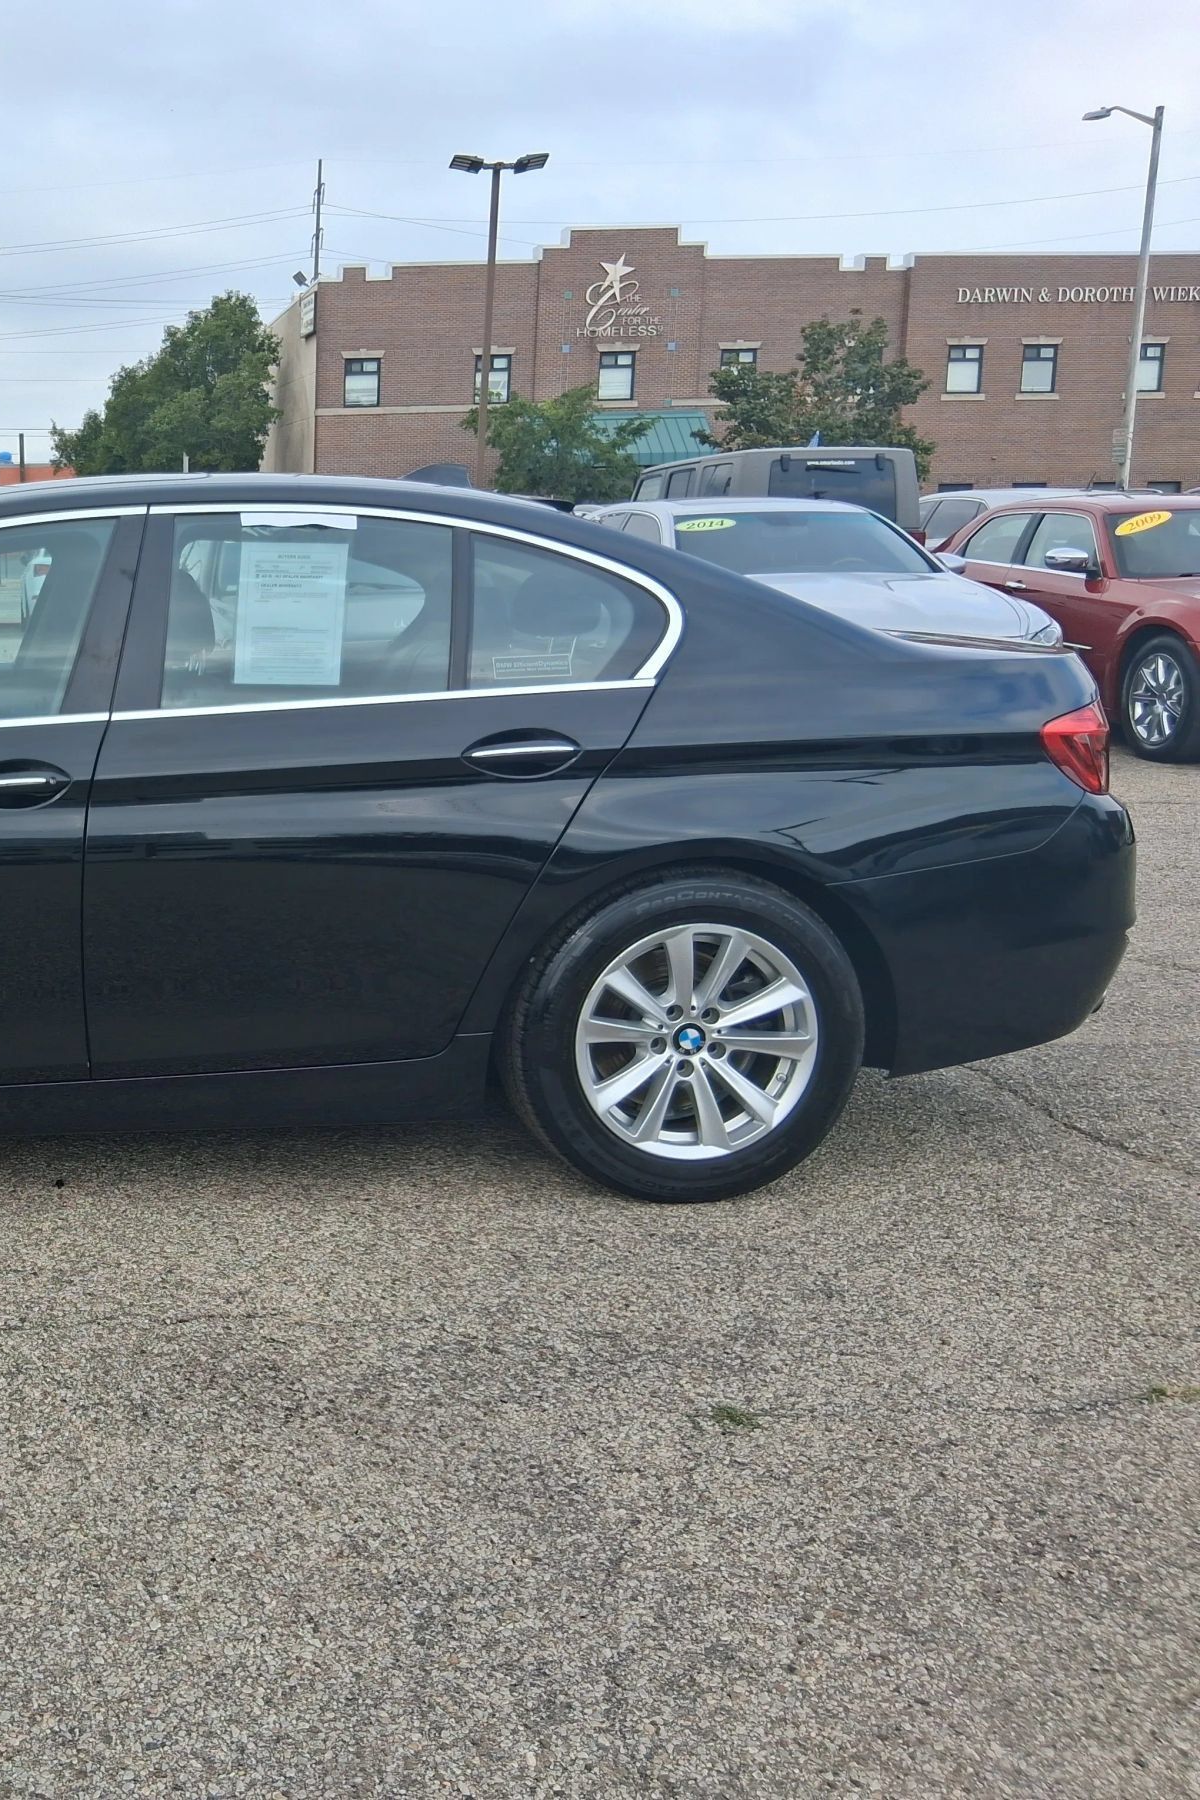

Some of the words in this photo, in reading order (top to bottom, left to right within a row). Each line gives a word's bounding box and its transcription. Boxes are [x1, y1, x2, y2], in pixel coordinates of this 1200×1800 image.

[957, 287, 1033, 303] DARWIN
[1038, 287, 1052, 303] &
[1152, 286, 1200, 303] WIEK
[622, 316, 641, 326] FOR
[645, 315, 662, 325] THE
[576, 326, 658, 338] HOMELESS
[686, 519, 725, 531] 2014
[1126, 513, 1162, 531] 2009
